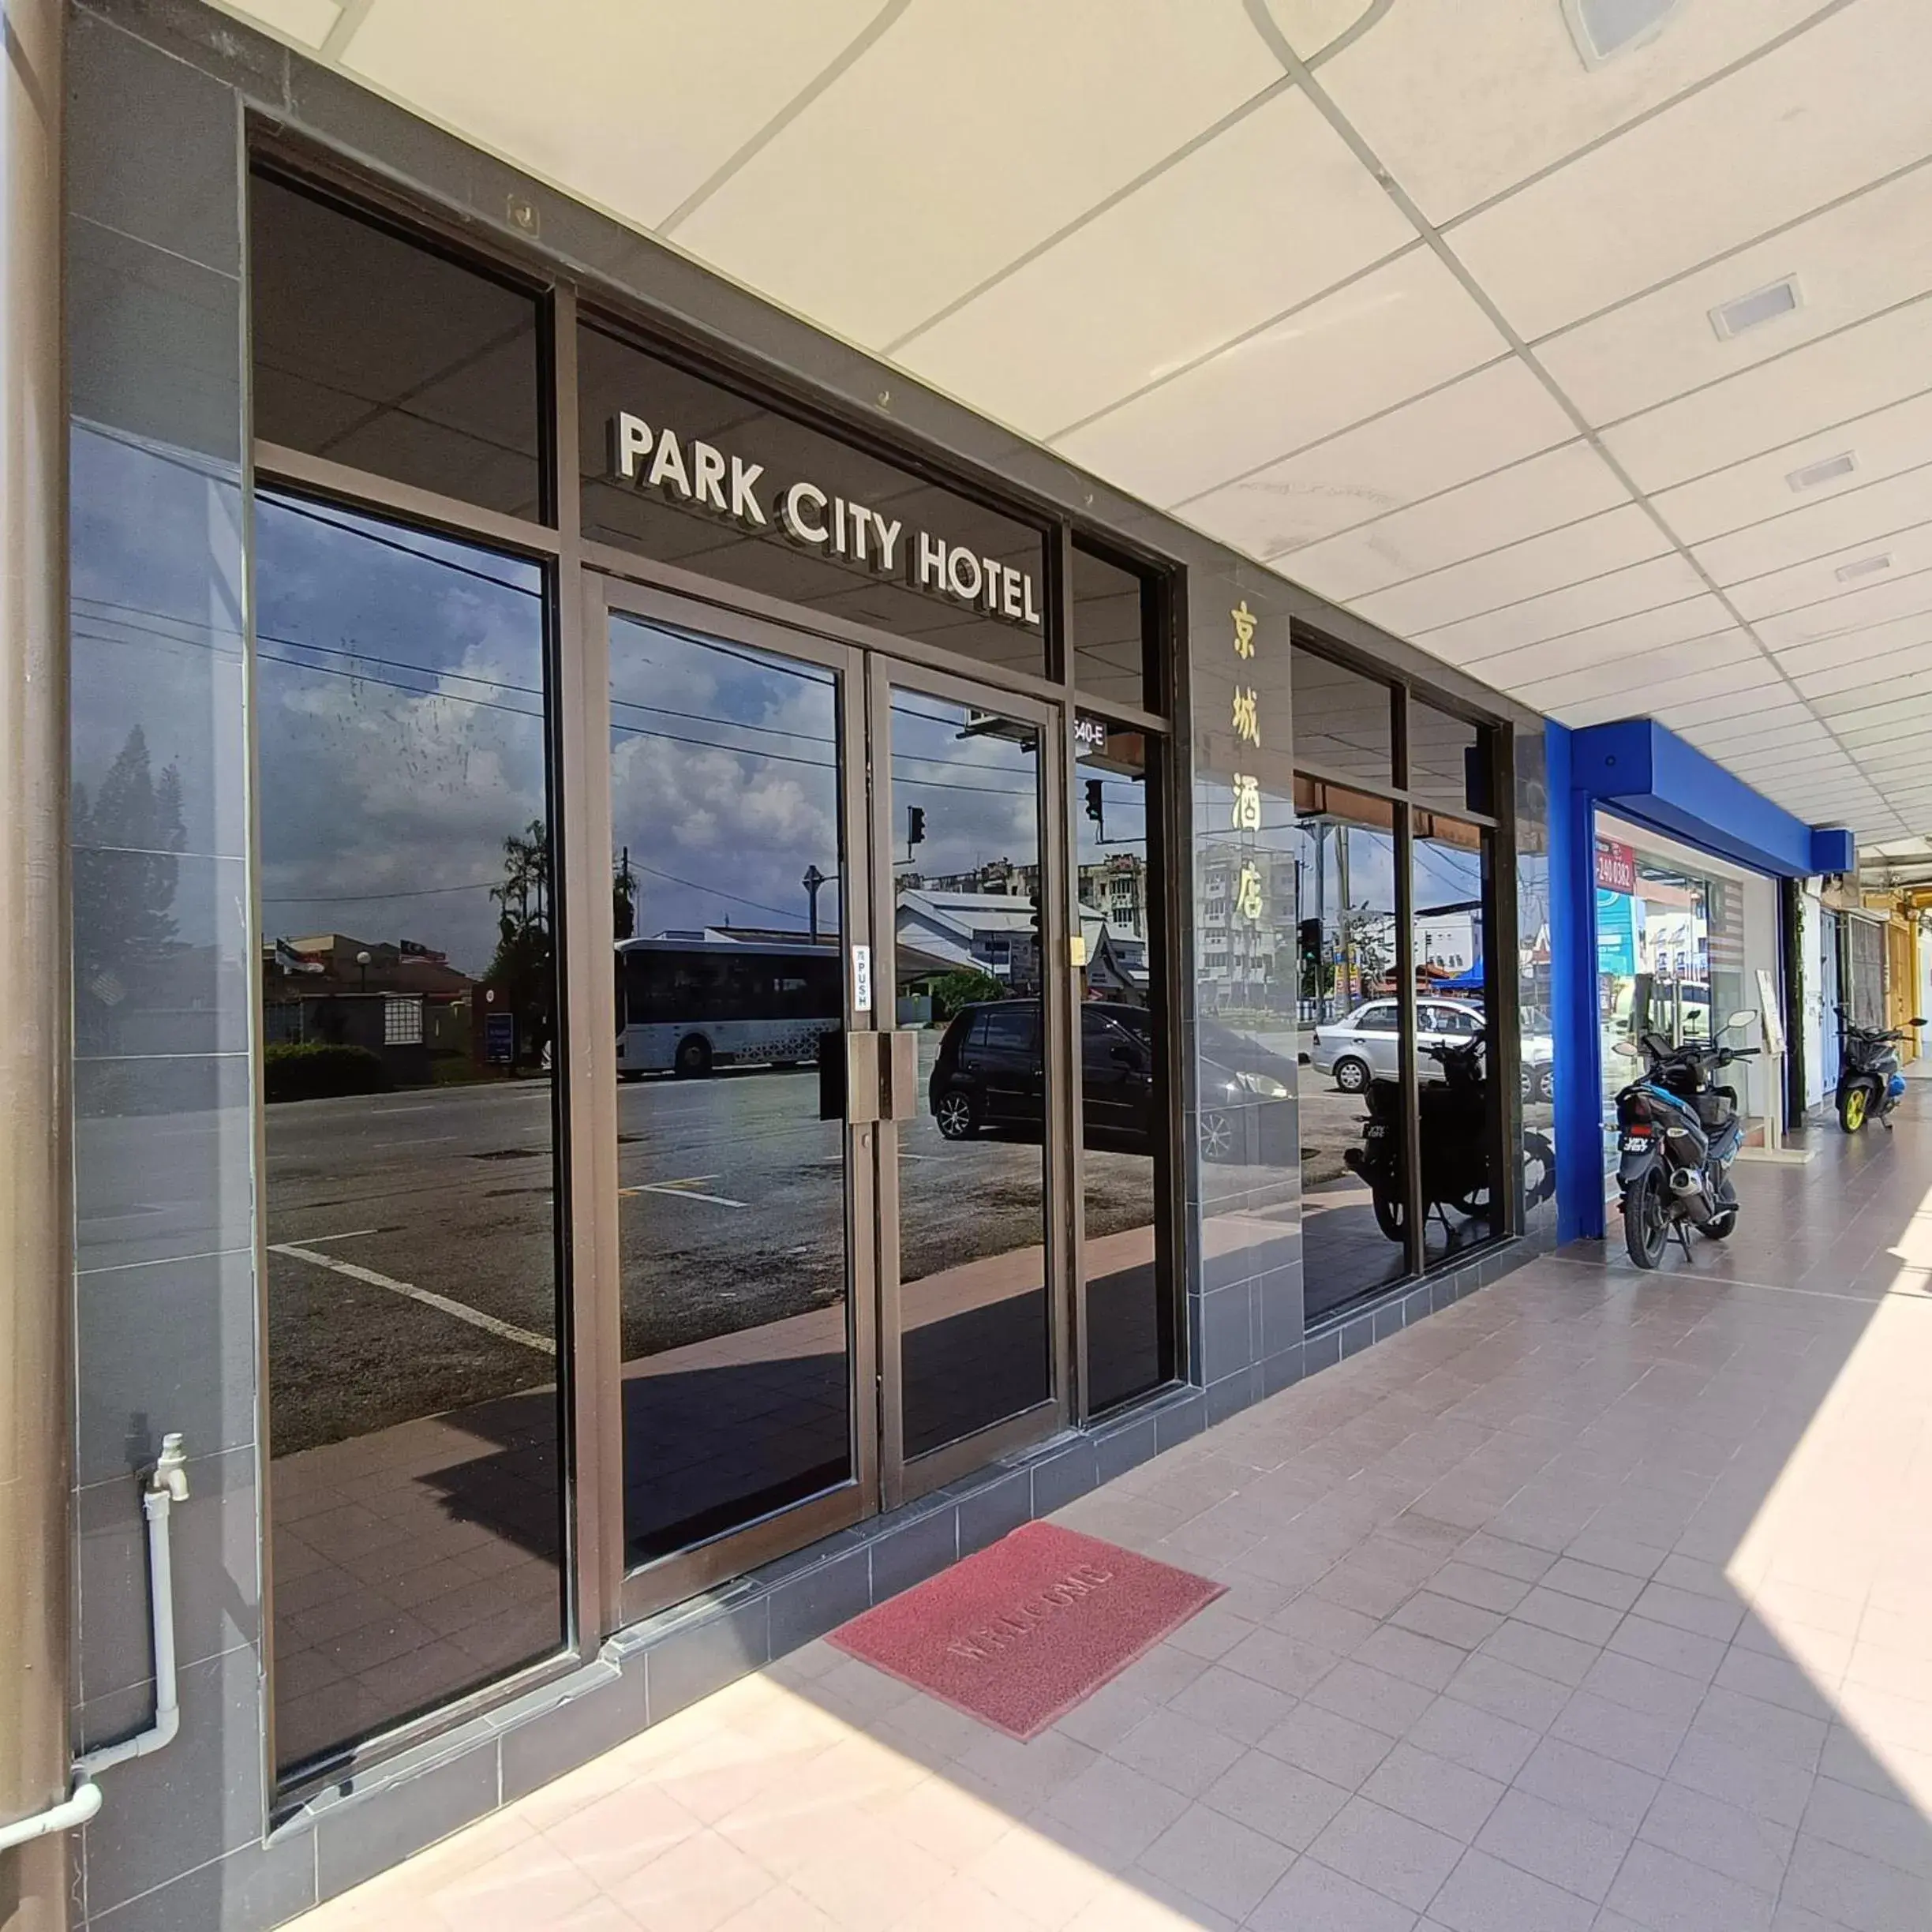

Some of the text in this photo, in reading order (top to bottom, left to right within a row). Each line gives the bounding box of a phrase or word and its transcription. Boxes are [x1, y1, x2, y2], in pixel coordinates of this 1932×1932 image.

[620, 411, 1040, 625] PARK CITY HOTEL
[1230, 601, 1263, 919] 京城酒店
[858, 963, 867, 1006] PUSH
[947, 1565, 1114, 1663] WELCOME
